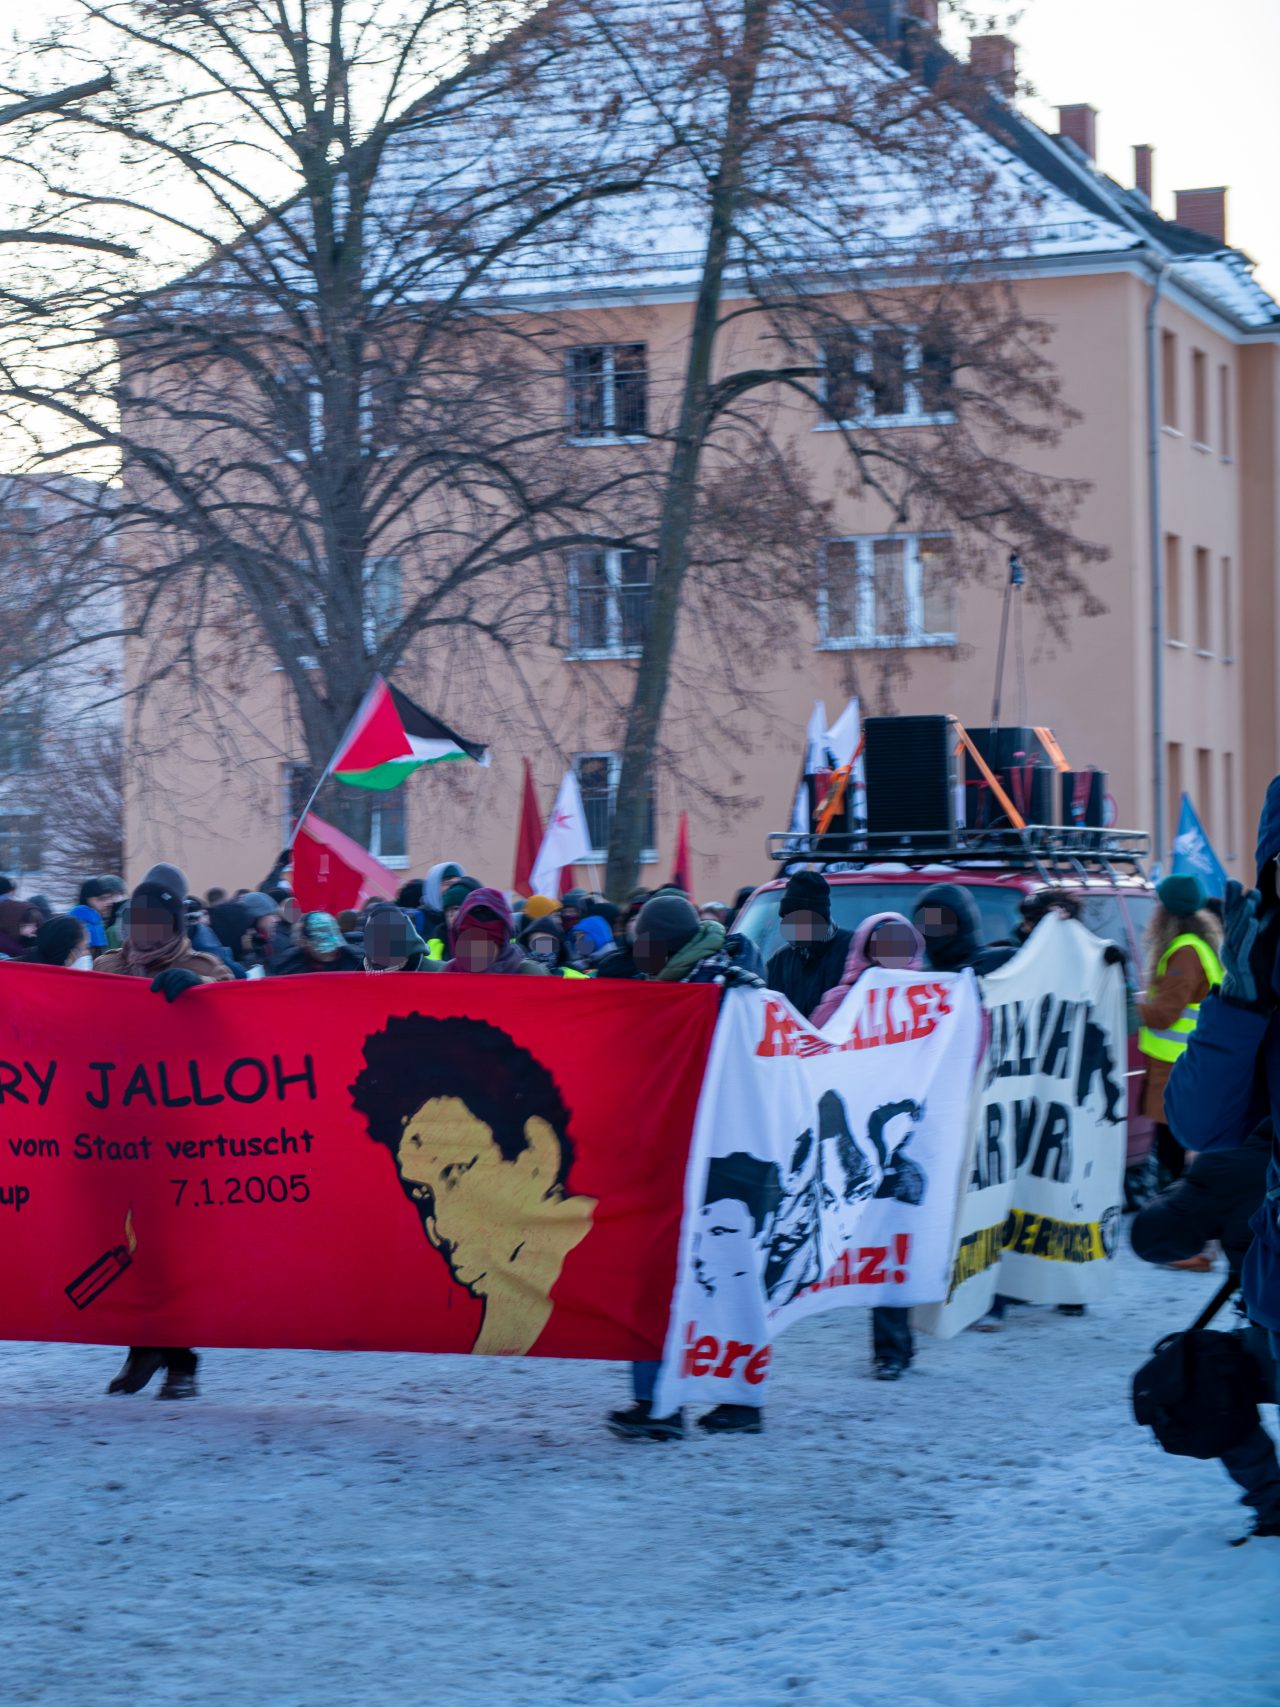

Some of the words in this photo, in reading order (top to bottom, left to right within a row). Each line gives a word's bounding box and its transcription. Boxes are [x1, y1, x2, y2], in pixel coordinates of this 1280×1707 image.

[85, 1054, 317, 1110] JALLOH
[7, 1138, 60, 1157] vom
[72, 1133, 153, 1161] Staat
[165, 1127, 315, 1159] vertuscht
[169, 1173, 311, 1207] 7.1.2005
